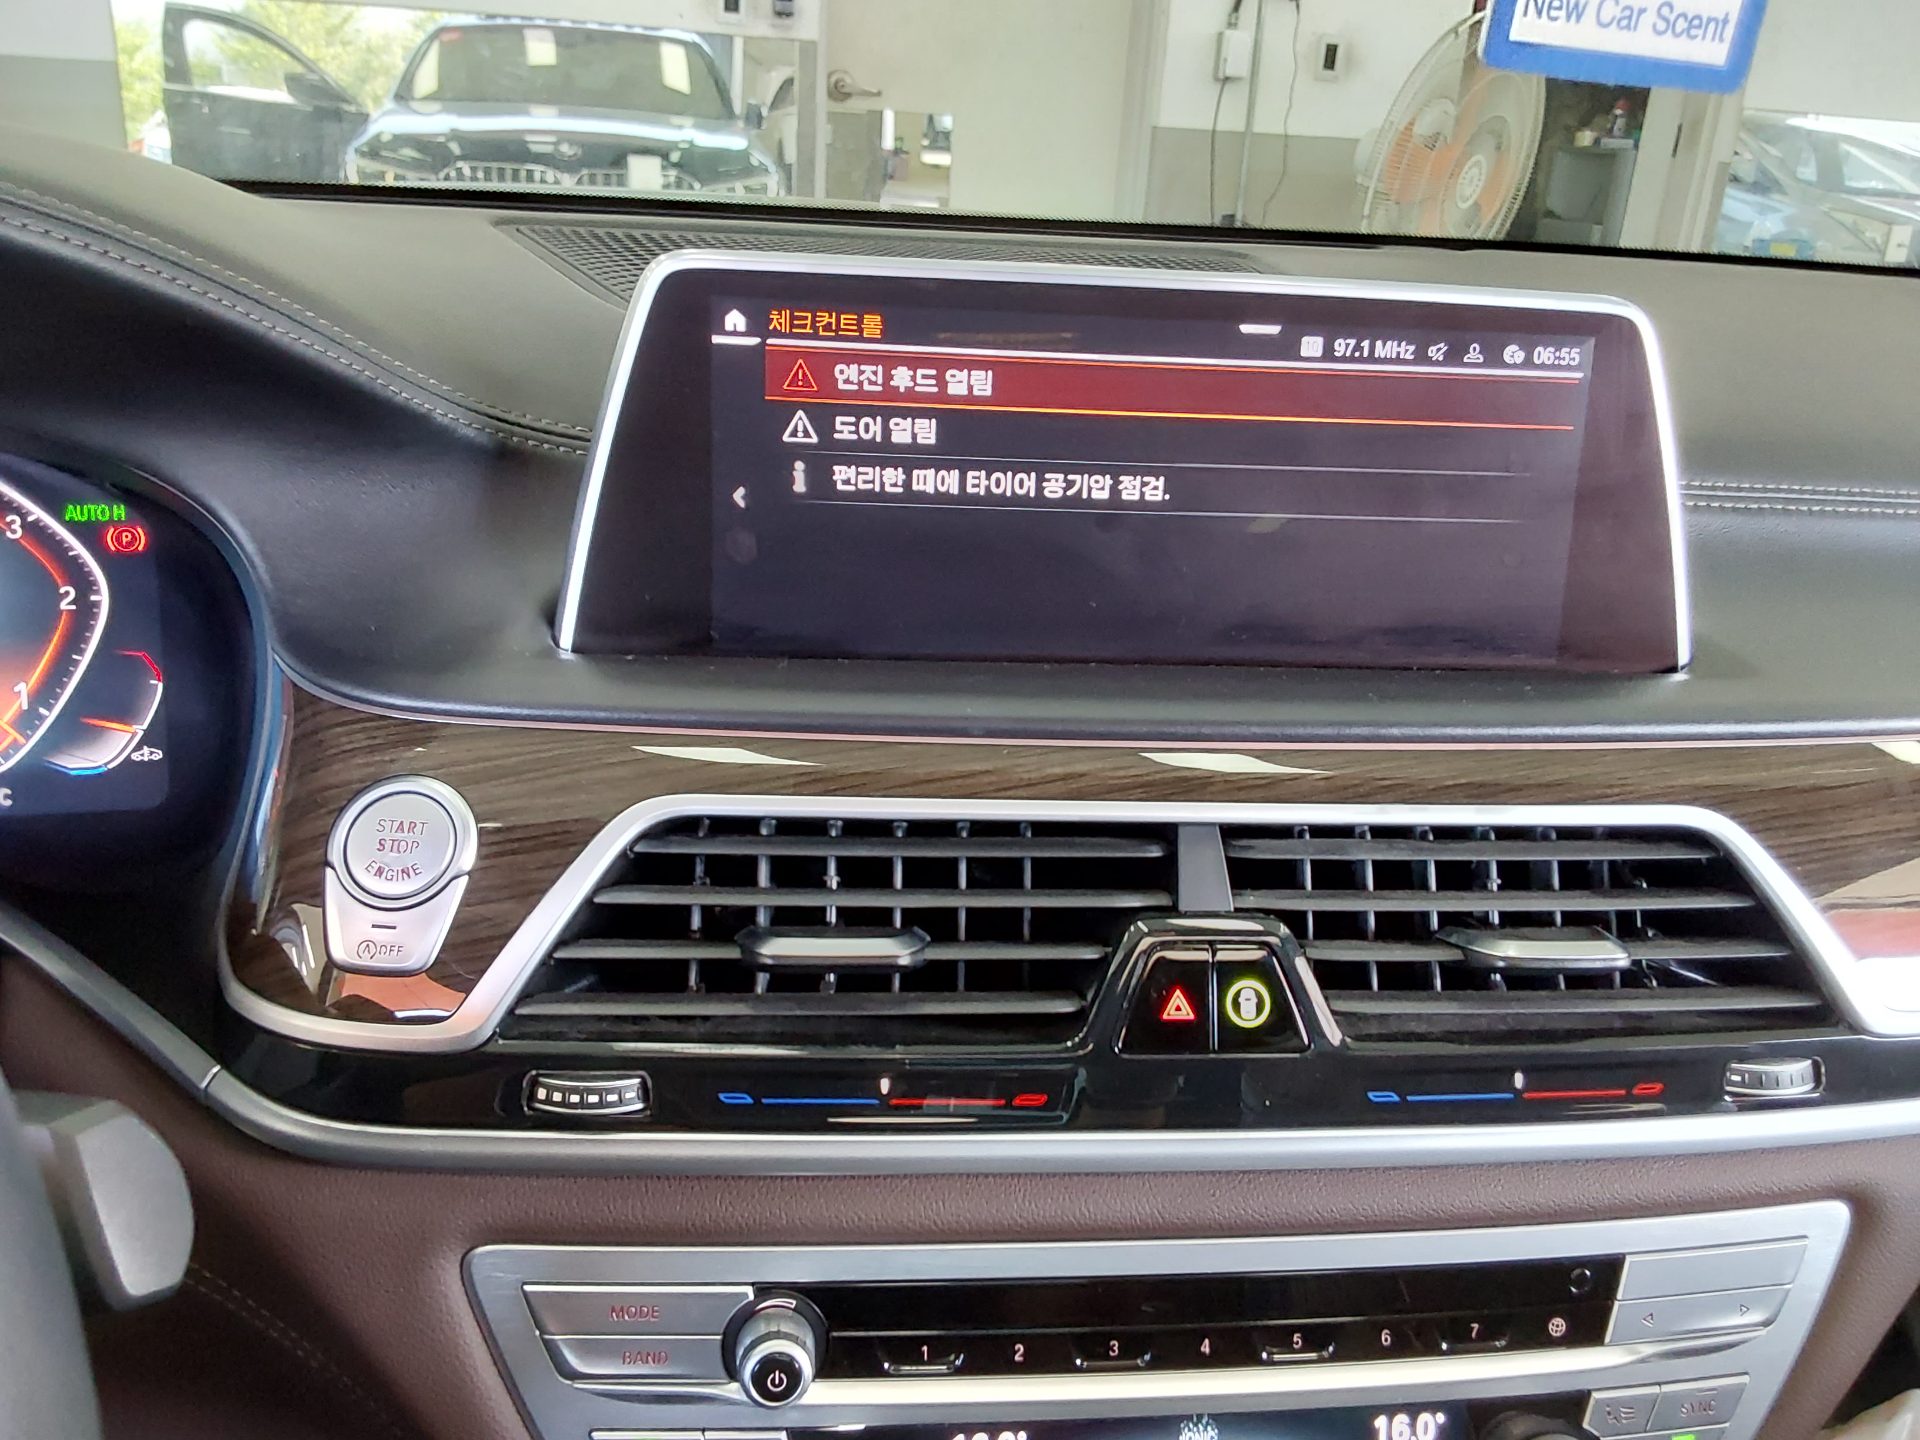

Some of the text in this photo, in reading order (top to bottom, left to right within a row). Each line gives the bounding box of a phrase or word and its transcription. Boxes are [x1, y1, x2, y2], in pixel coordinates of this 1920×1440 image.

[1522, 0, 1730, 44] New Car Scent
[768, 309, 883, 338] 체크컨트롤
[1333, 338, 1370, 358] 97.1
[1374, 339, 1416, 360] MHz
[1532, 346, 1580, 366] 06:55
[833, 363, 993, 397] 엔진 후드 열림
[832, 415, 937, 445] 도어 열림
[832, 464, 906, 493] 편리한
[911, 468, 960, 496] 때에
[966, 469, 1036, 498] 타이어
[65, 504, 126, 522] AUTO H
[5, 514, 23, 540] 3
[59, 585, 77, 610] 2
[13, 681, 29, 710] 1
[376, 818, 430, 836] START
[376, 837, 420, 855] STOP
[364, 859, 424, 882] ENGINE
[610, 1305, 661, 1322] MODE
[1380, 1328, 1392, 1346] 6
[1469, 1322, 1480, 1339] 7
[1108, 1340, 1120, 1357] 3
[1200, 1337, 1211, 1357] 4
[1292, 1332, 1303, 1350] 5
[622, 1350, 669, 1367] BAND
[921, 1344, 928, 1362] 1
[1014, 1343, 1025, 1363] 2
[1679, 1399, 1717, 1418] SYNC
